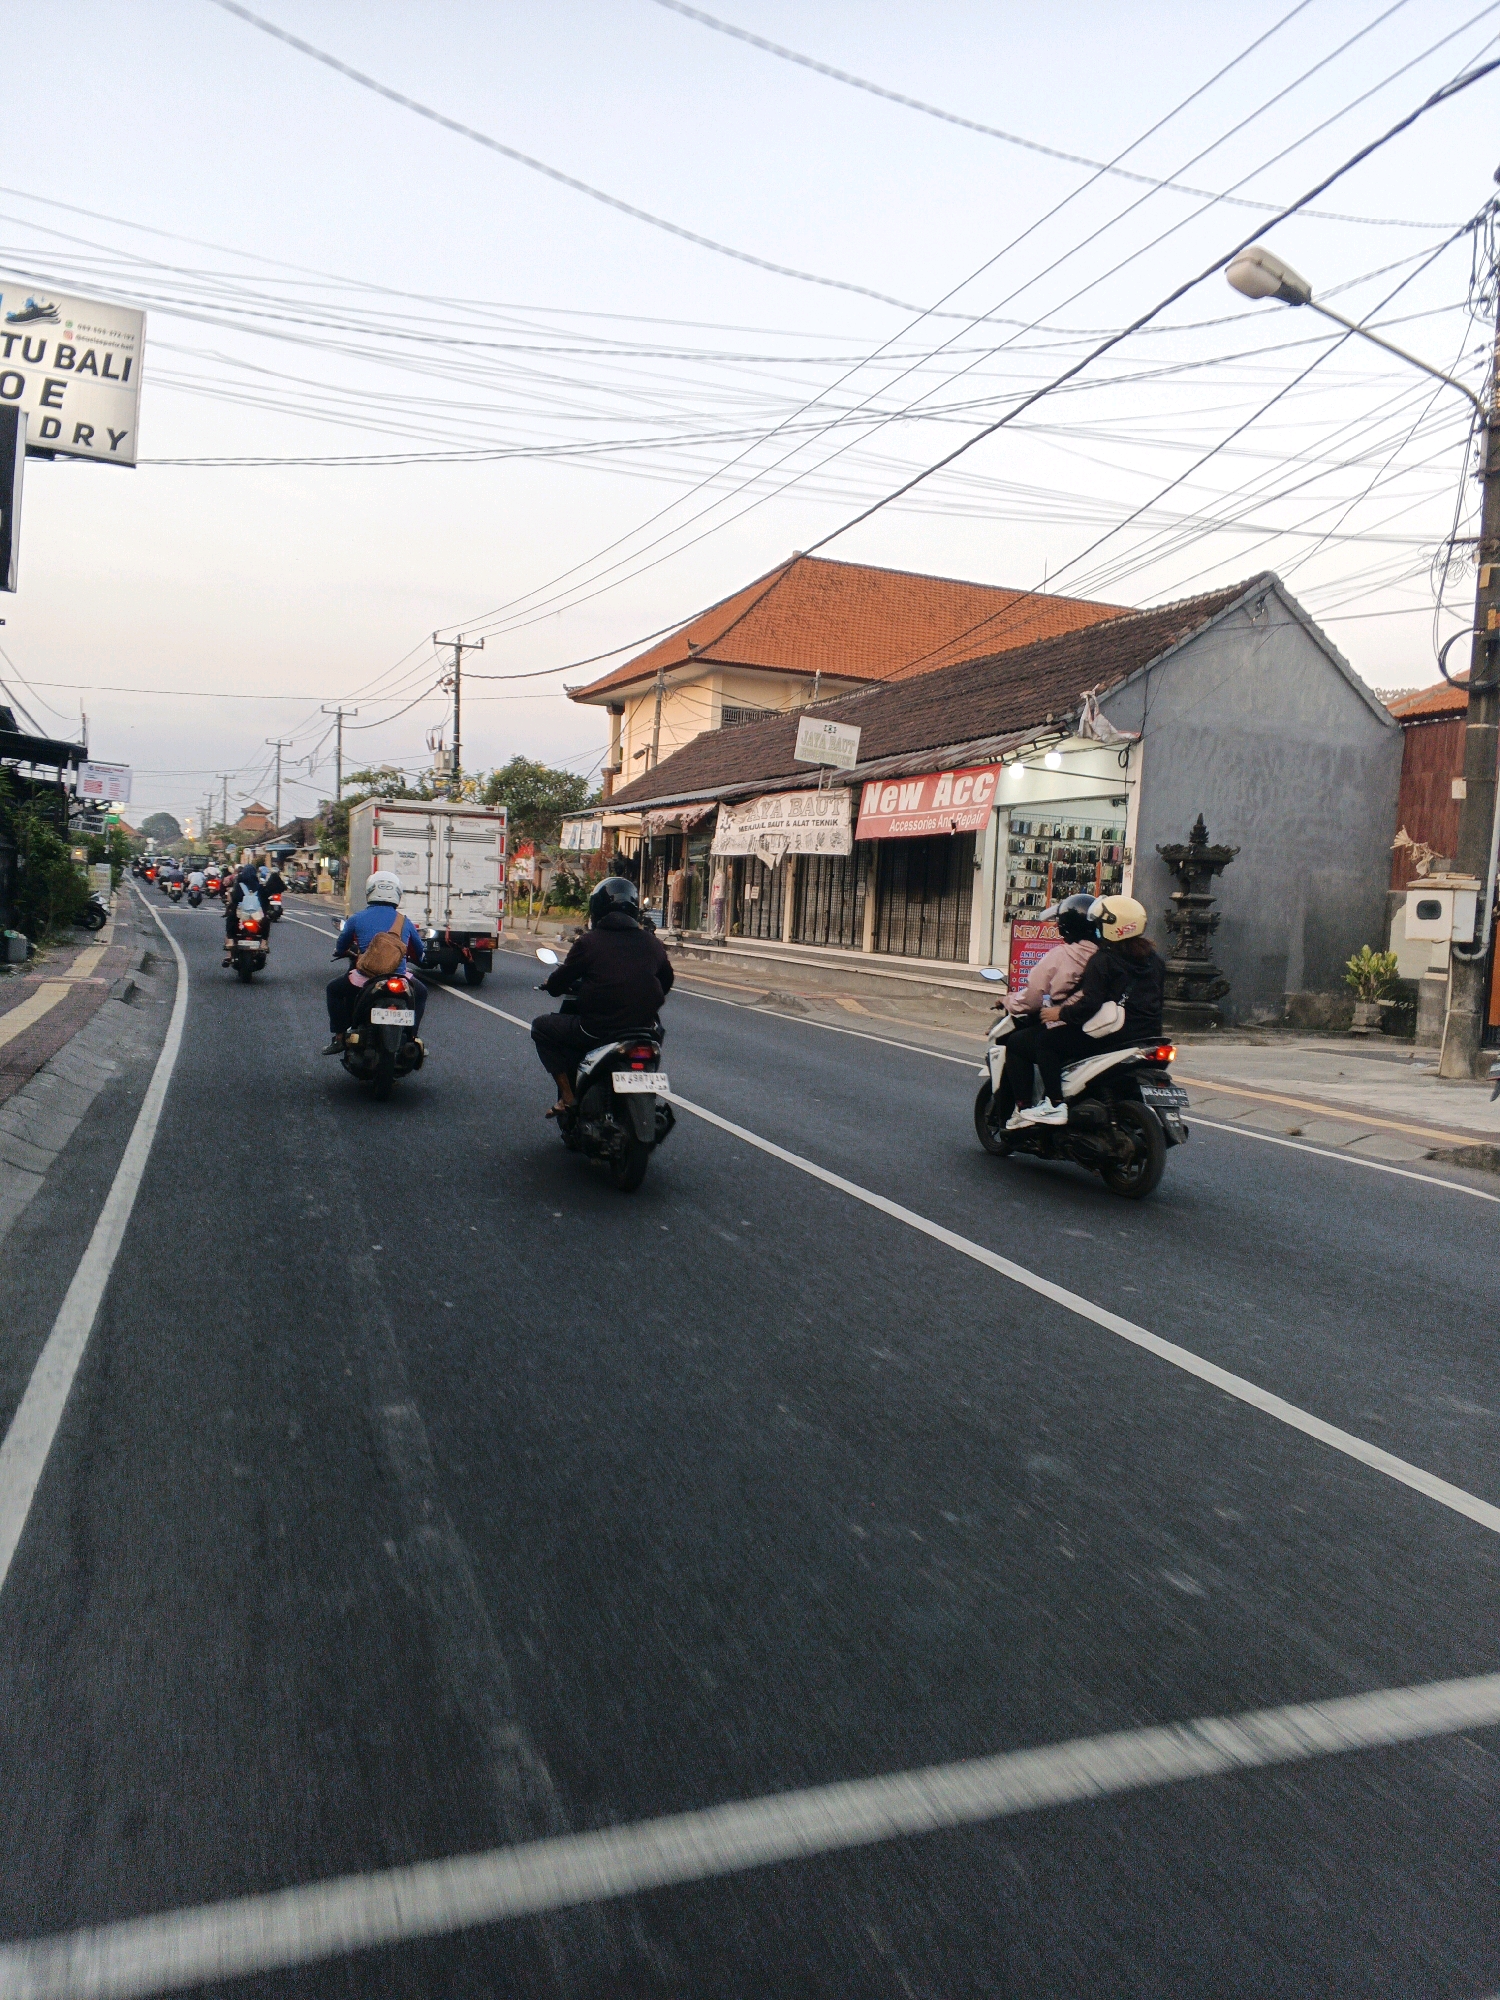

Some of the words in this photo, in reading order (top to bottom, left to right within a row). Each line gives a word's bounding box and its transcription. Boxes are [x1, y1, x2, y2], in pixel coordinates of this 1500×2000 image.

[53, 341, 134, 382] BALI
[39, 415, 129, 451] DRY
[788, 795, 845, 818] BAUT
[767, 820, 784, 829] BAUT
[785, 820, 791, 828] &
[792, 820, 810, 828] ALAT
[812, 819, 839, 828] TEKNIK
[889, 817, 937, 832] Accessories
[937, 813, 955, 828] And
[955, 810, 985, 828] Repair
[1014, 925, 1040, 938] NEW
[615, 1073, 626, 1082] DK
